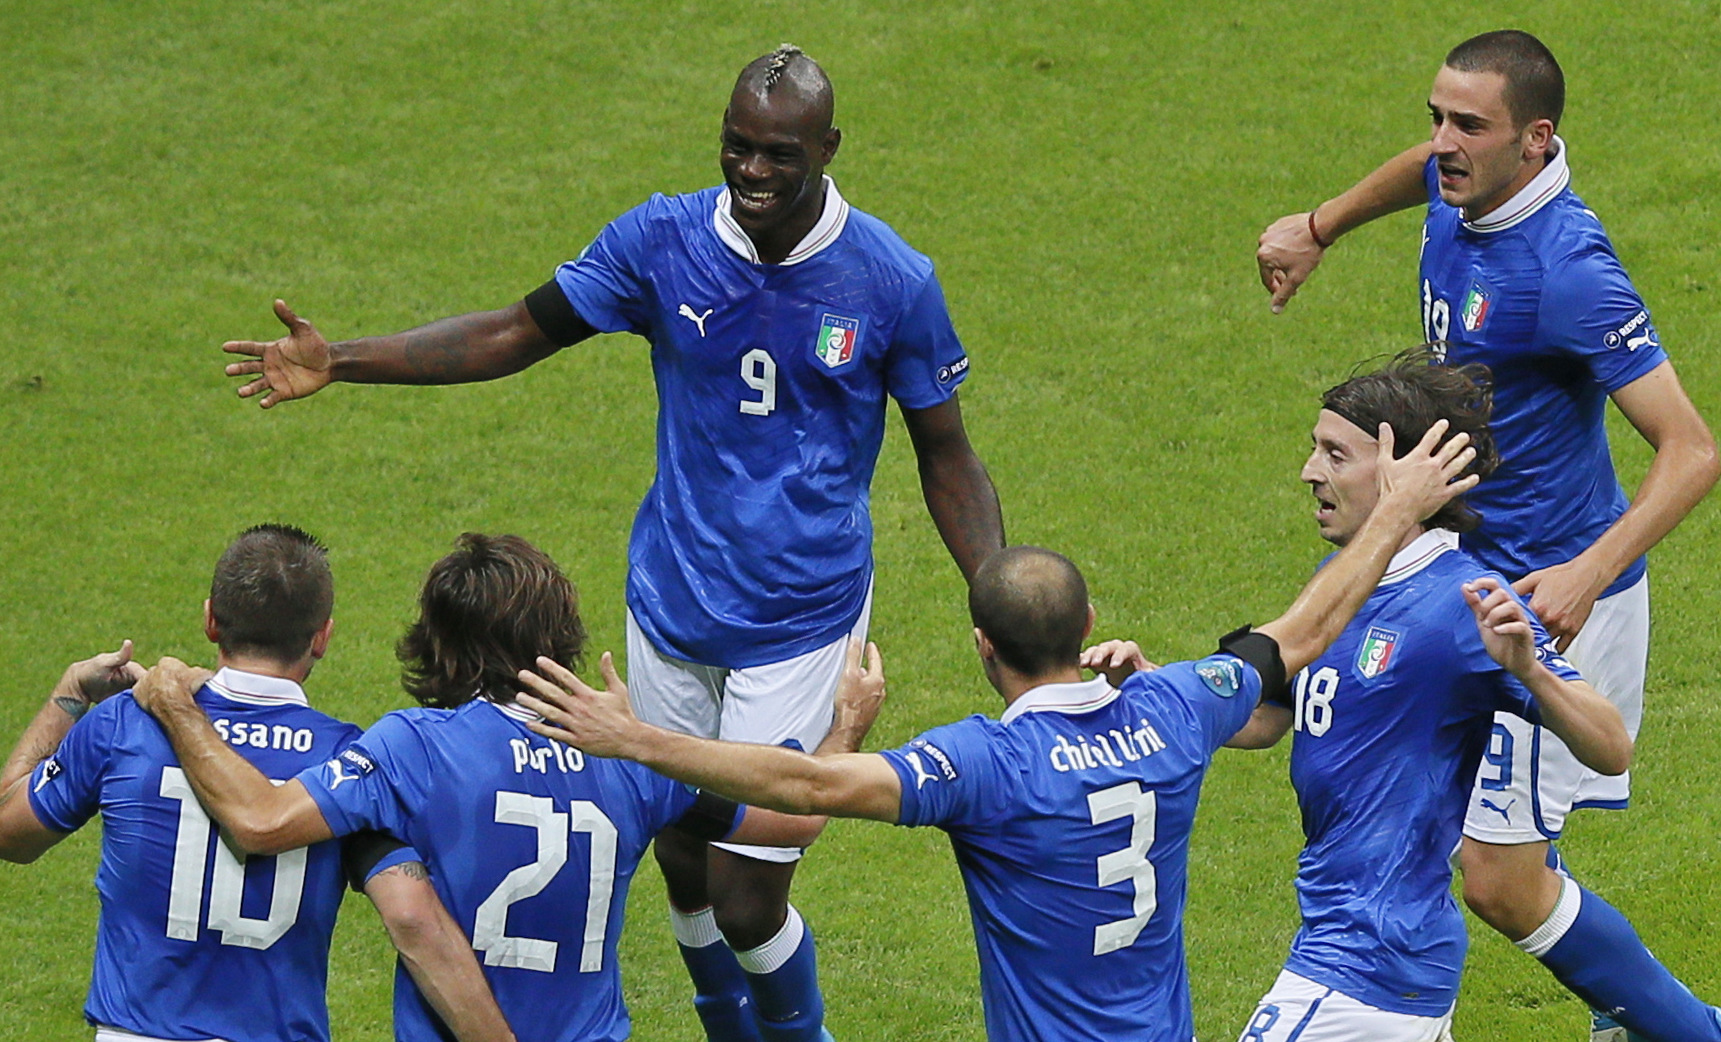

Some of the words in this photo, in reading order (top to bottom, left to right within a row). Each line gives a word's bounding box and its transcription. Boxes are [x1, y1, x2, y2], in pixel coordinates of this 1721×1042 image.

[1423, 278, 1450, 365] 19
[1618, 310, 1648, 337] RESPECT
[740, 349, 777, 416] 9
[1372, 630, 1395, 642] ITALIA
[1294, 666, 1341, 738] 18
[509, 737, 585, 774] pirlo
[923, 743, 957, 780] RESPECT
[1050, 718, 1167, 773] chiellini
[159, 766, 309, 950] 10
[472, 790, 619, 973] 21
[1086, 781, 1158, 957] 3
